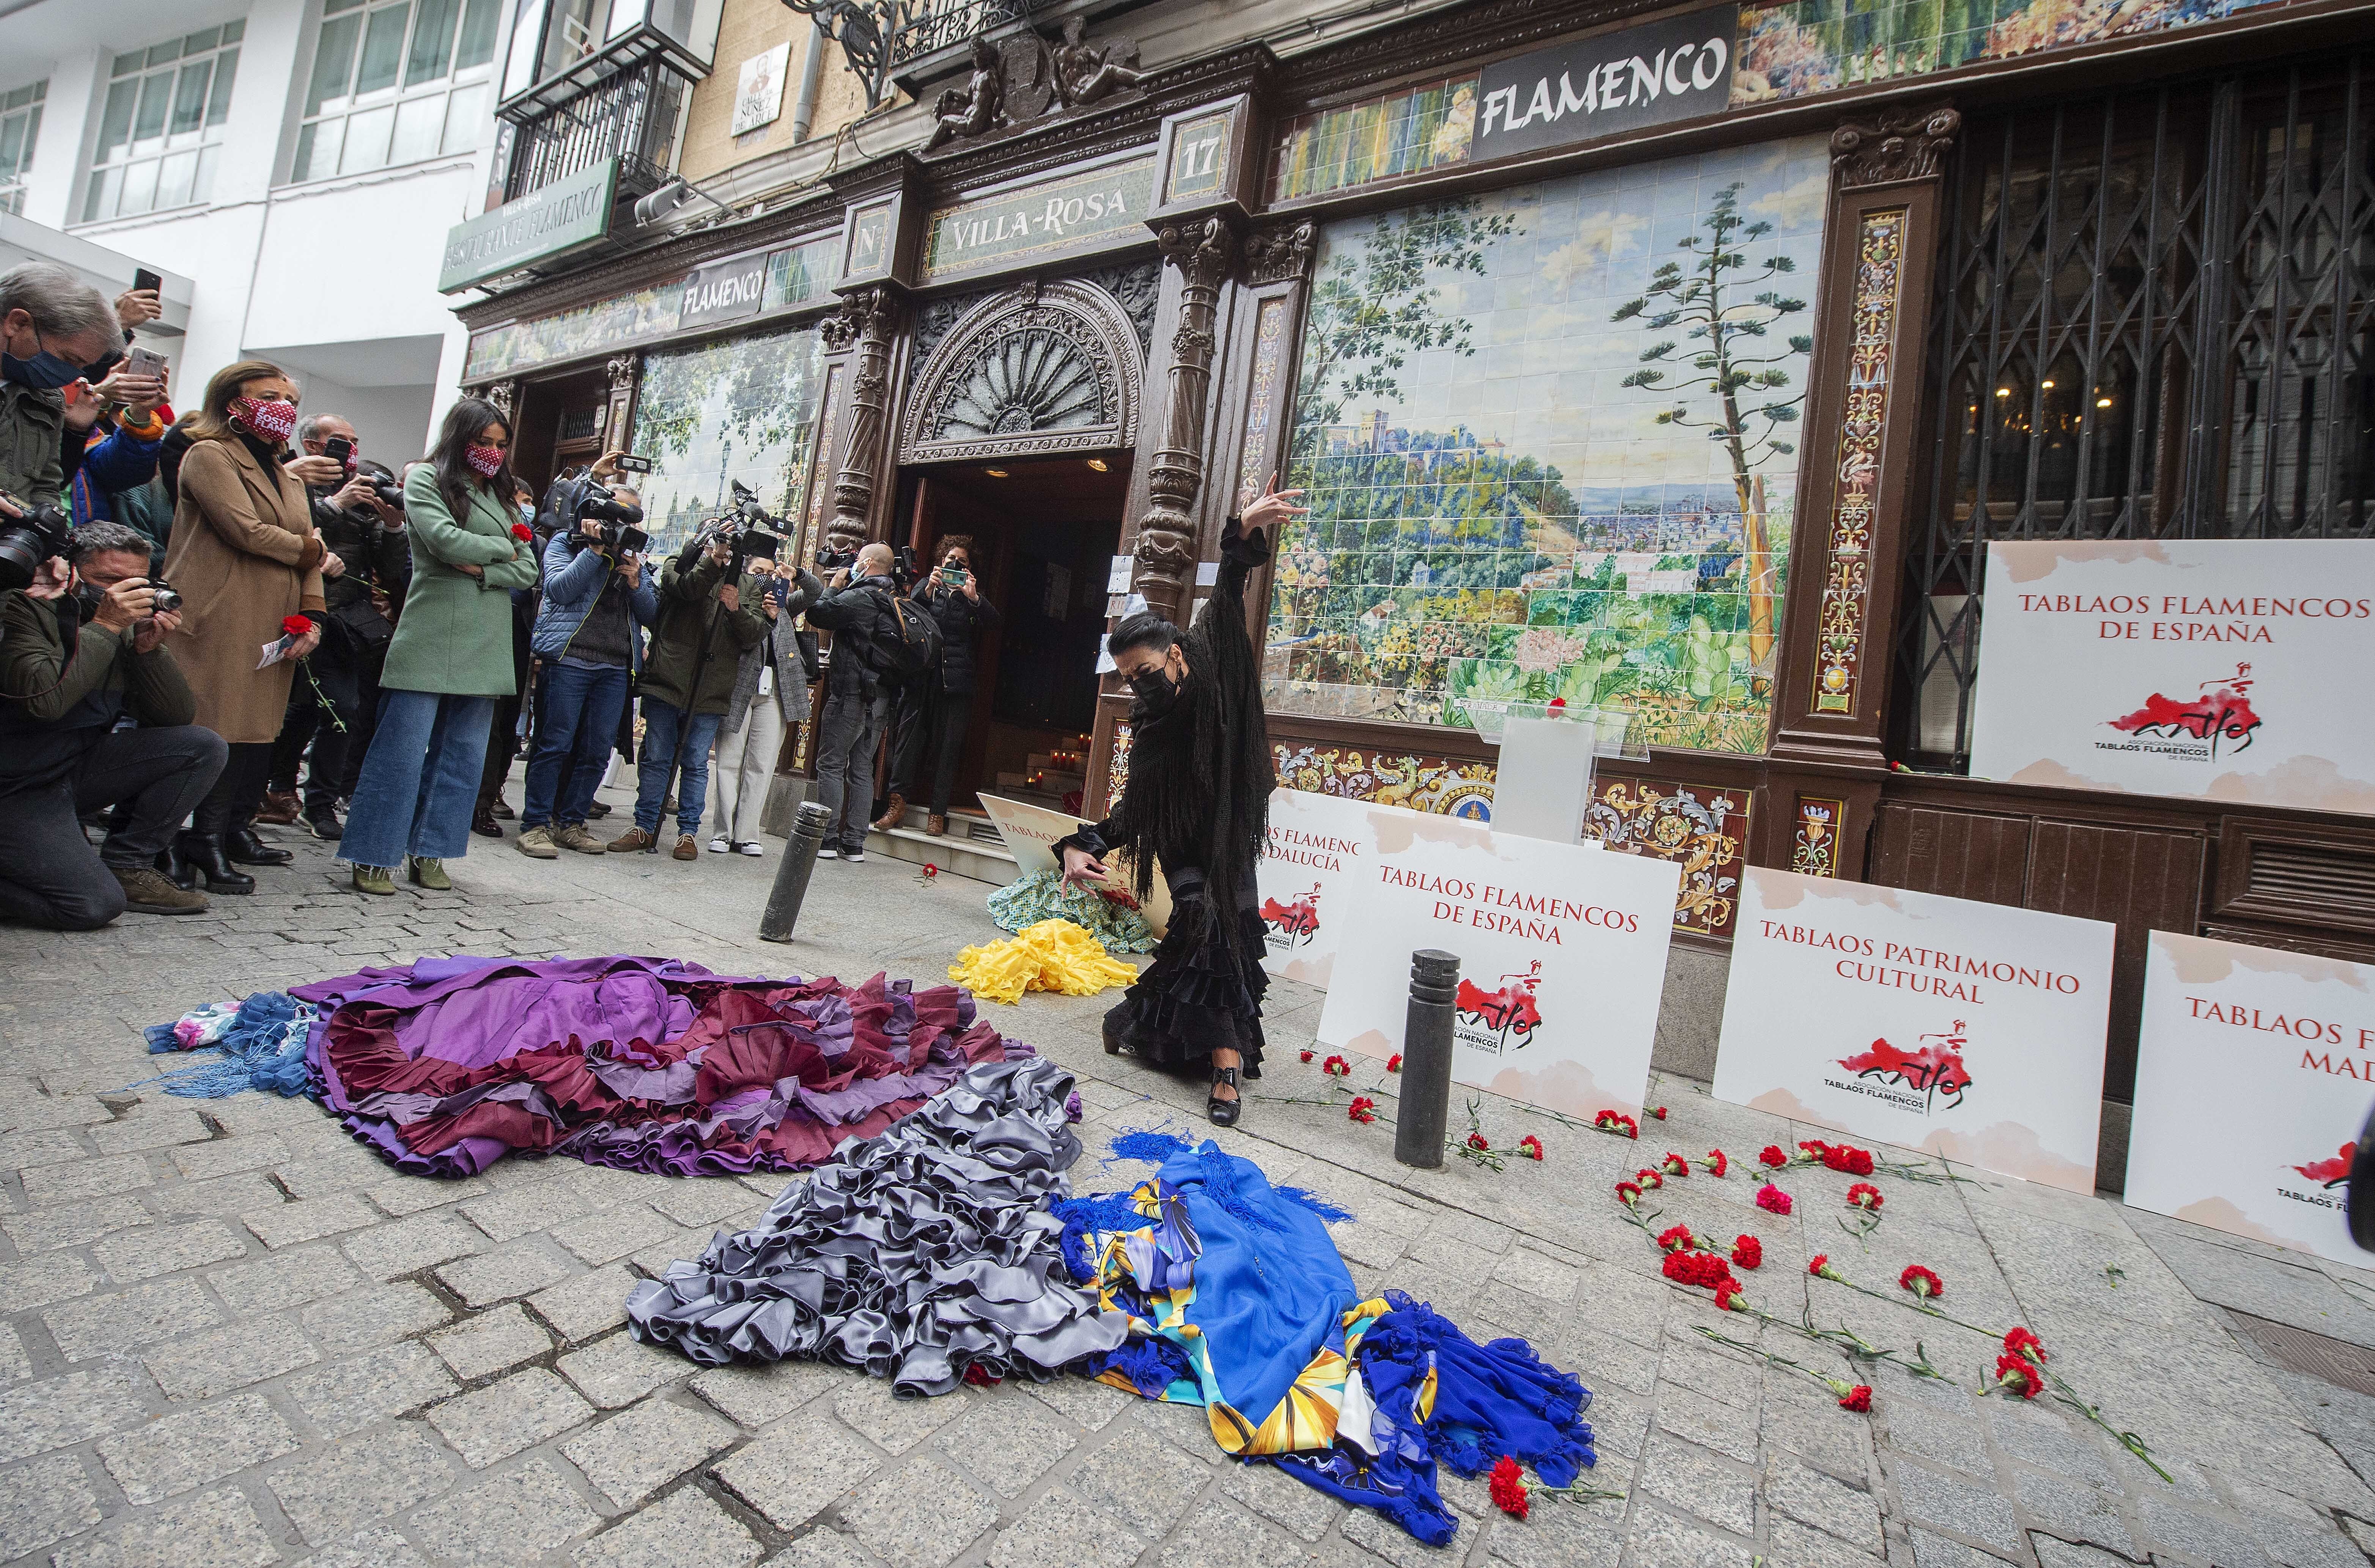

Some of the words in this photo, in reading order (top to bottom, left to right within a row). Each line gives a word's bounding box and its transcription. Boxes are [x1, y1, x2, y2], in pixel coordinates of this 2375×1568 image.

[1481, 37, 1727, 137] FLAMENCO
[742, 92, 762, 107] CALLE
[735, 120, 746, 132] DE
[749, 108, 773, 127] ARCE
[1181, 136, 1219, 180] 17
[443, 215, 525, 273] RESTAURANTE
[527, 182, 603, 240] FLAMENCO
[953, 188, 1127, 250] VILLA-ROSA
[683, 269, 763, 316] FLAMENCO
[255, 418, 291, 436] FLAME
[596, 409, 603, 423] 15
[694, 531, 707, 544] Canon
[1110, 600, 1125, 610] RIP
[2019, 594, 2150, 614] TABLAOS
[2162, 596, 2370, 618] FLAMENCOS
[2099, 621, 2139, 639] DE
[2152, 621, 2274, 644] ESPAÑA
[2094, 742, 2140, 751] TABLAOS
[2144, 745, 2209, 756] FLAMENCOS
[1450, 798, 1469, 817] ELISSIMA
[1284, 829, 1361, 856] FLAMENC
[1262, 845, 1341, 872] DALUCÍA
[1380, 865, 1475, 900] TABLAOS
[1483, 886, 1639, 933] FLAMENCOS
[1433, 901, 1463, 923] DE
[1472, 910, 1562, 945] ESPAÑA
[1264, 936, 1290, 946] AMENCOS
[1760, 920, 1874, 956] TABLAOS
[1884, 942, 2080, 995] PATRIMONIO
[1836, 959, 1984, 1004] CULTURAL
[2185, 996, 2342, 1045] TABLAOS
[1453, 1031, 1498, 1048] LAMENCOS
[1455, 1026, 1471, 1035] ACIÓN
[1472, 1030, 1499, 1042] NACIONAL
[1475, 1044, 1497, 1054] ESPAÑA
[1824, 1078, 1864, 1094] TABLAOS
[1867, 1089, 1925, 1109] FLAMENCOS
[1853, 1081, 1892, 1094] ASOCIACIÓN
[1893, 1089, 1925, 1102] NACIONAL
[1898, 1104, 1924, 1115] ESPAÑA
[2277, 1188, 2333, 1208] TABLAOS
